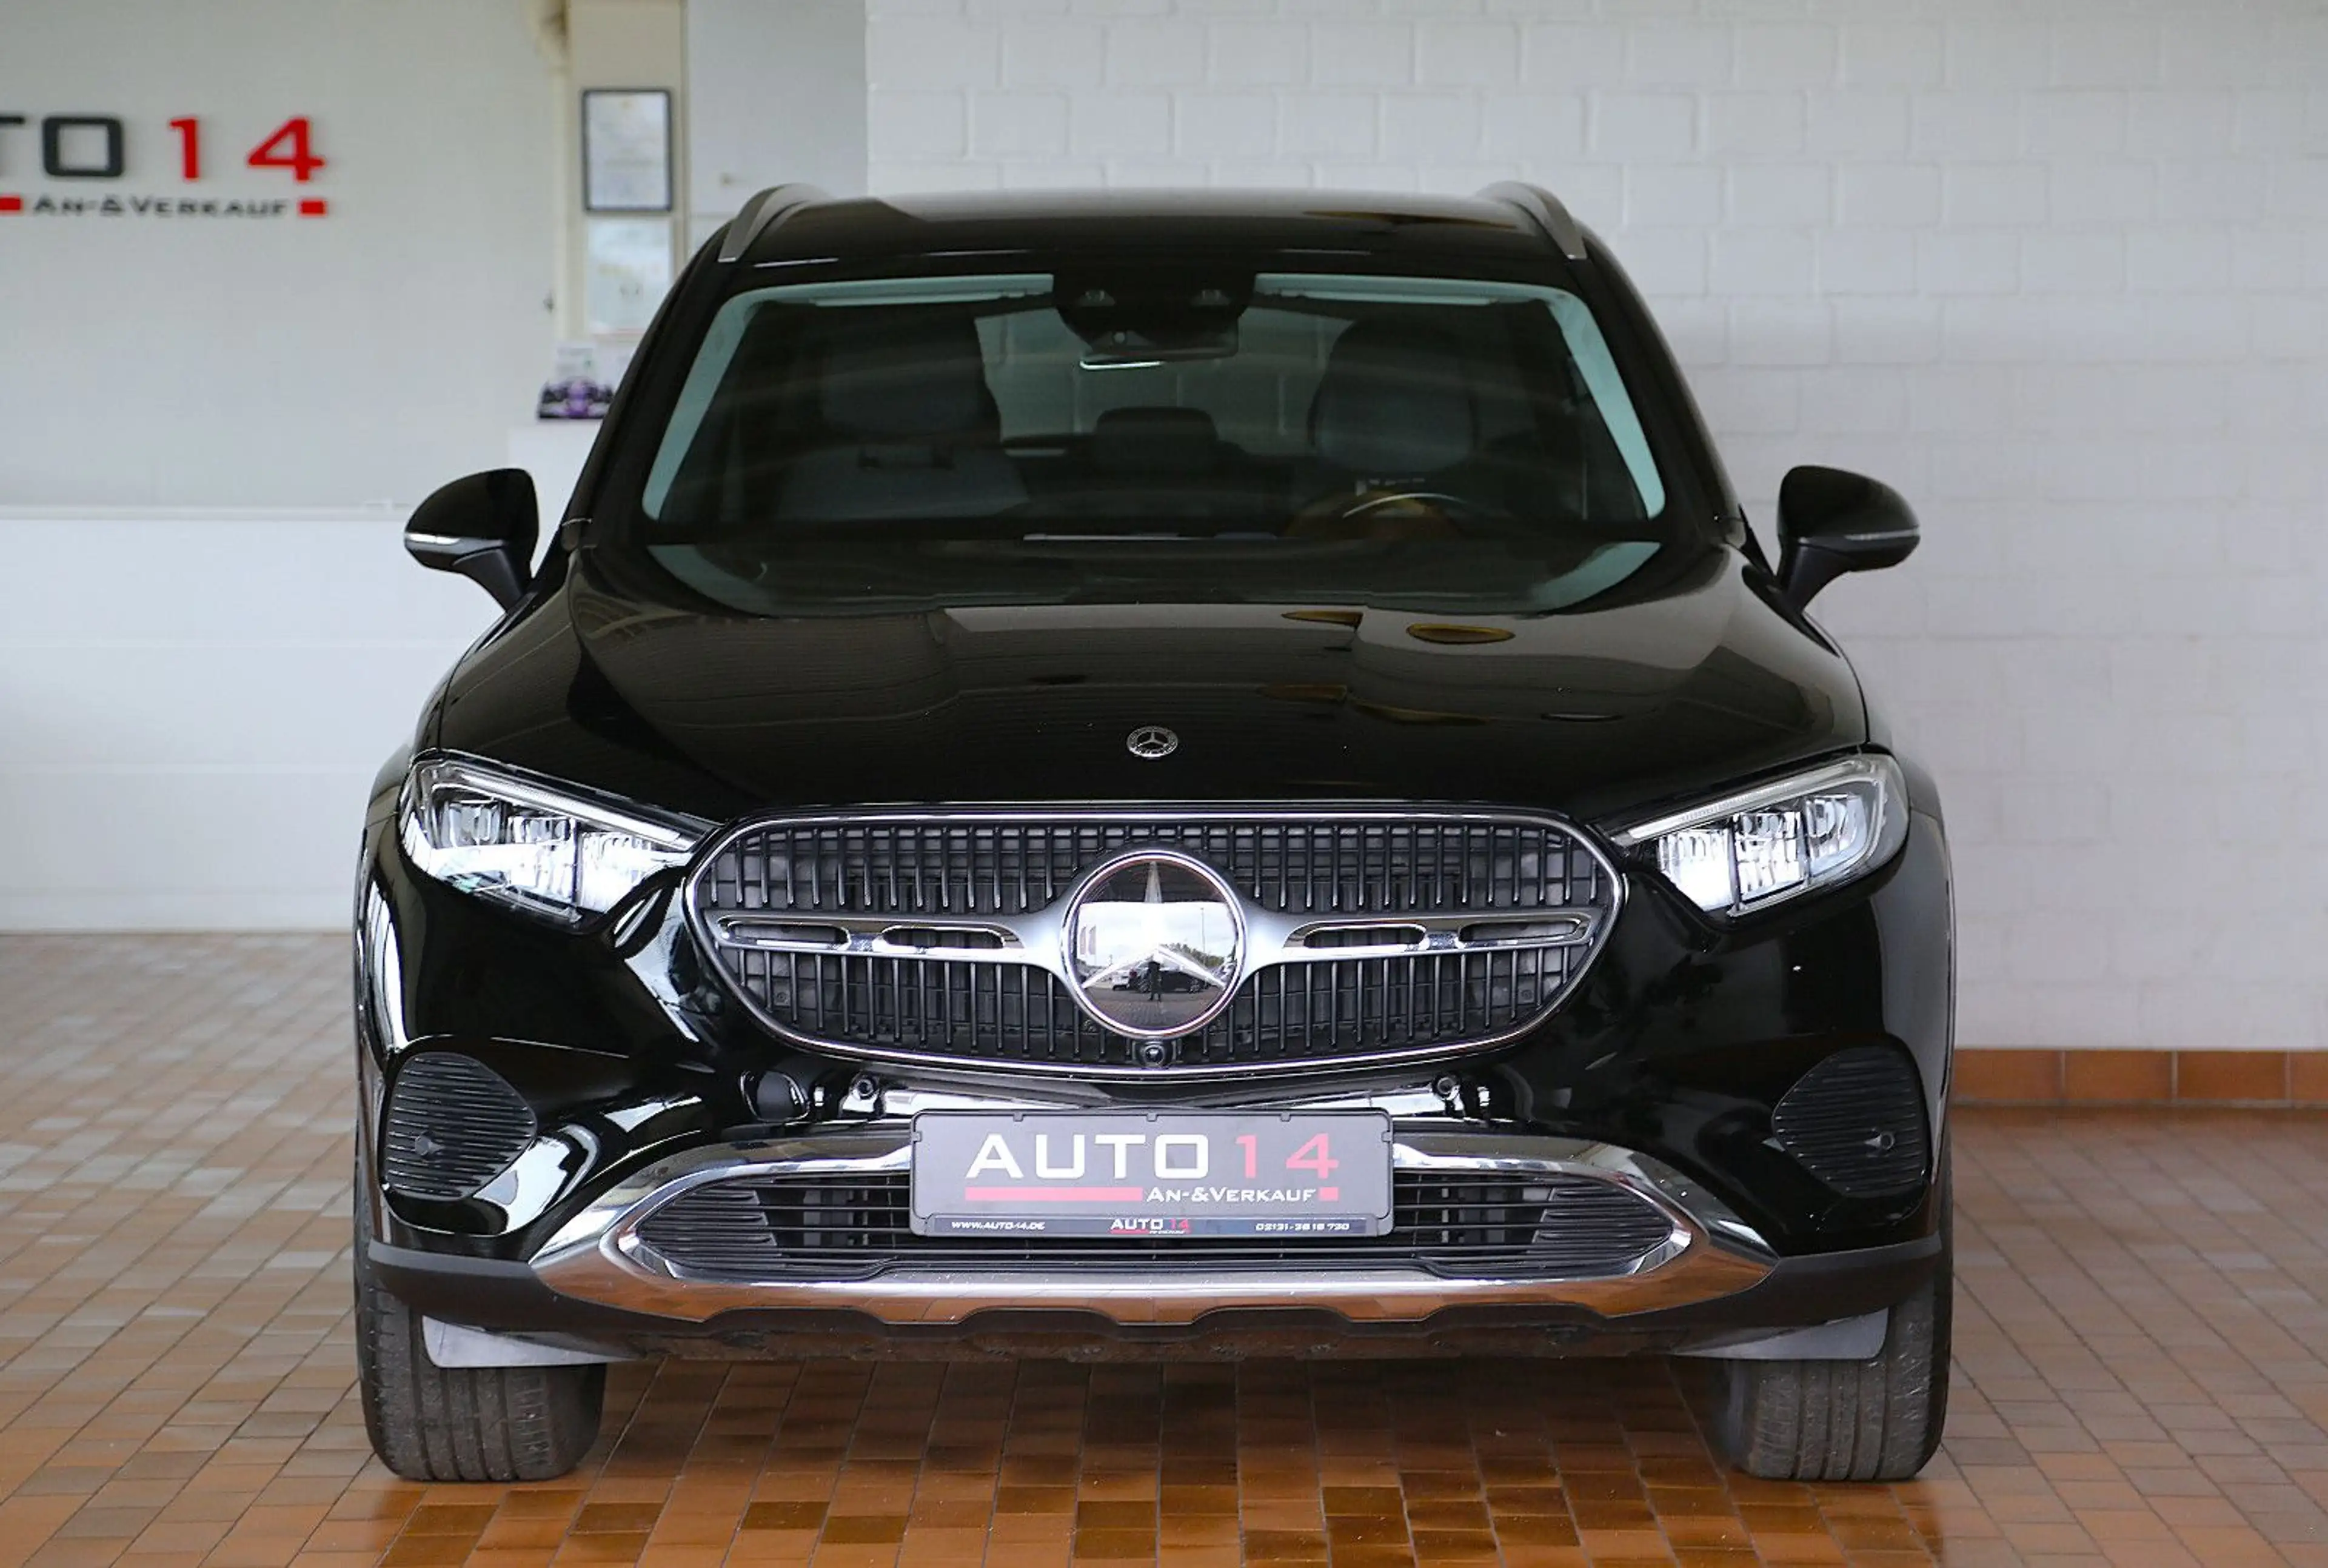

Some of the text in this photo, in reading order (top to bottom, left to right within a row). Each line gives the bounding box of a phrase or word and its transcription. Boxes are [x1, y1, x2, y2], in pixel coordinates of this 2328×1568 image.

[170, 116, 325, 182] 14
[966, 1133, 1339, 1179] AUTO 14
[1110, 1218, 1163, 1230] AUTO
